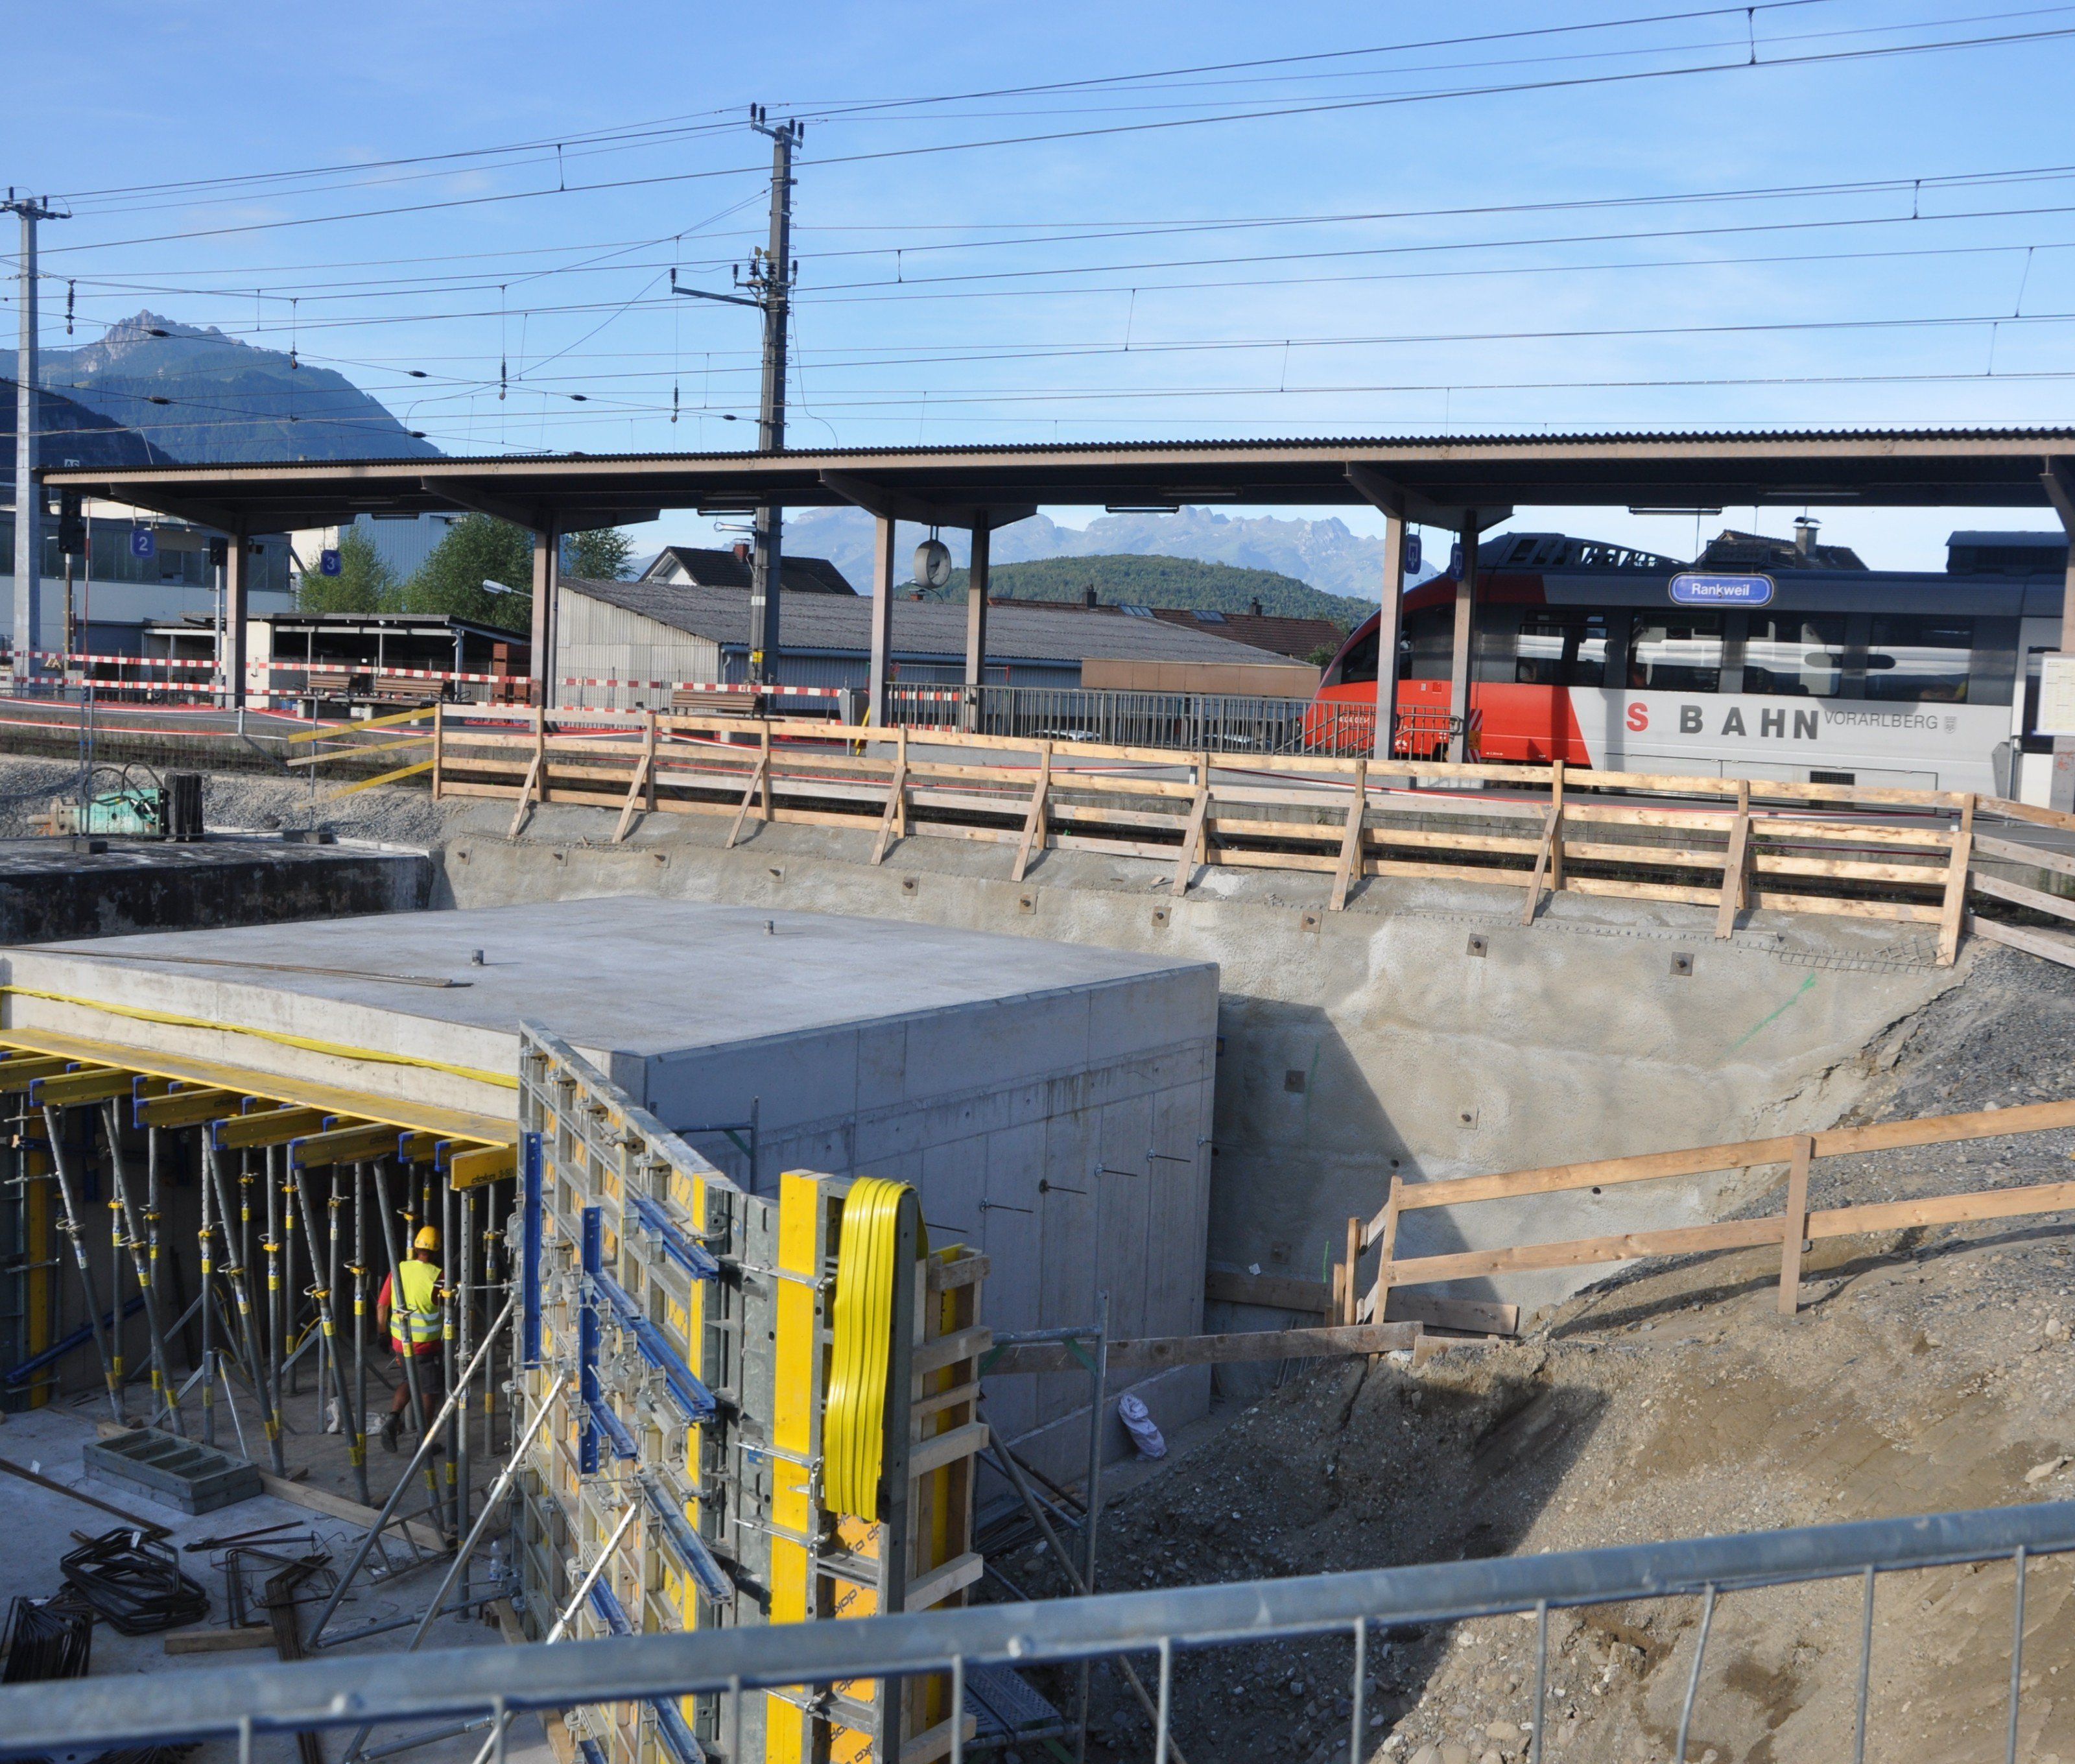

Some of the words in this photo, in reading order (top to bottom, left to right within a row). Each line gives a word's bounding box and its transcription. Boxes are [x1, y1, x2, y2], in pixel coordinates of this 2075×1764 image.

[139, 536, 148, 551] 2
[327, 556, 335, 570] 3
[1691, 583, 1751, 596] Rankweil
[1626, 702, 1649, 732] S
[1679, 704, 1819, 740] BAHN
[1823, 710, 1939, 730] VORARLBERG
[471, 1173, 496, 1184] doka
